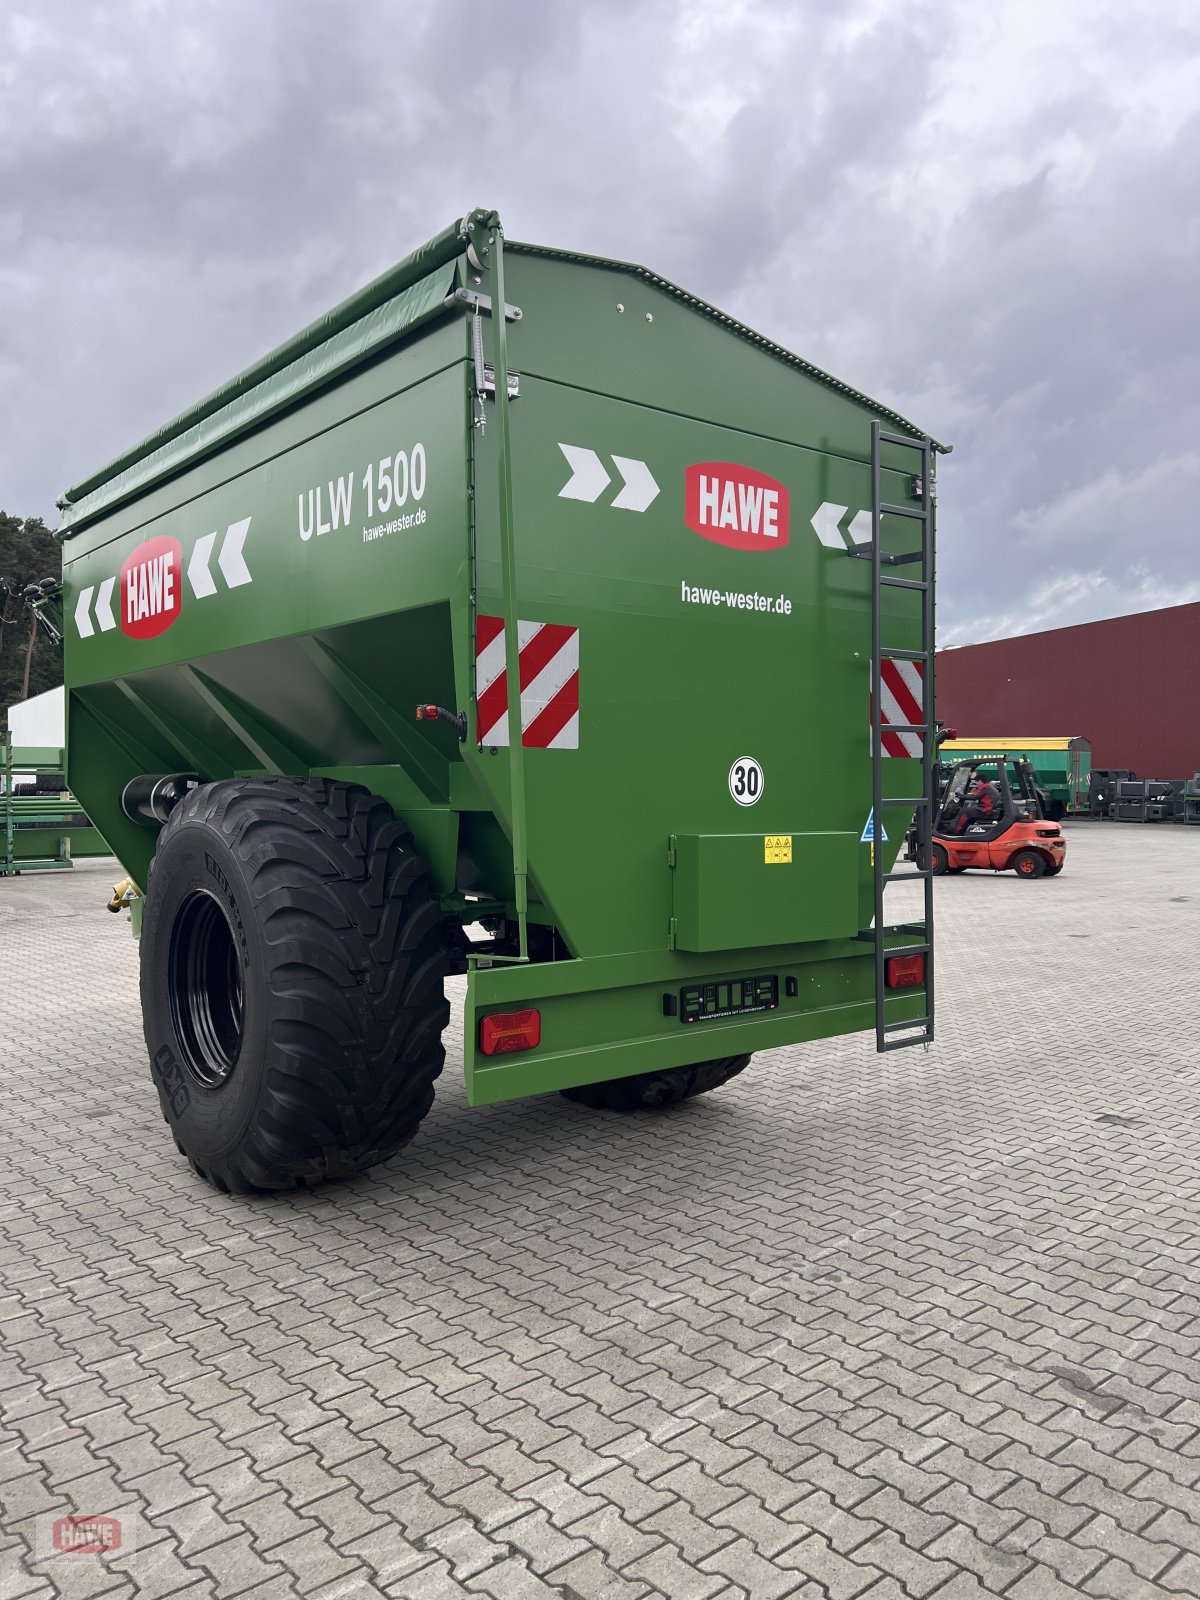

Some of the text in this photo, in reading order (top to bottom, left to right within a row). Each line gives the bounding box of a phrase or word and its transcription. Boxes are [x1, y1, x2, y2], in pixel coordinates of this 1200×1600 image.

[298, 442, 427, 542] ULW 1500
[699, 474, 779, 538] HAWE
[362, 506, 427, 543] hawe-wester.de
[126, 550, 175, 624] HAWE
[681, 580, 792, 615] hawe-wester.de
[734, 765, 759, 797] 30
